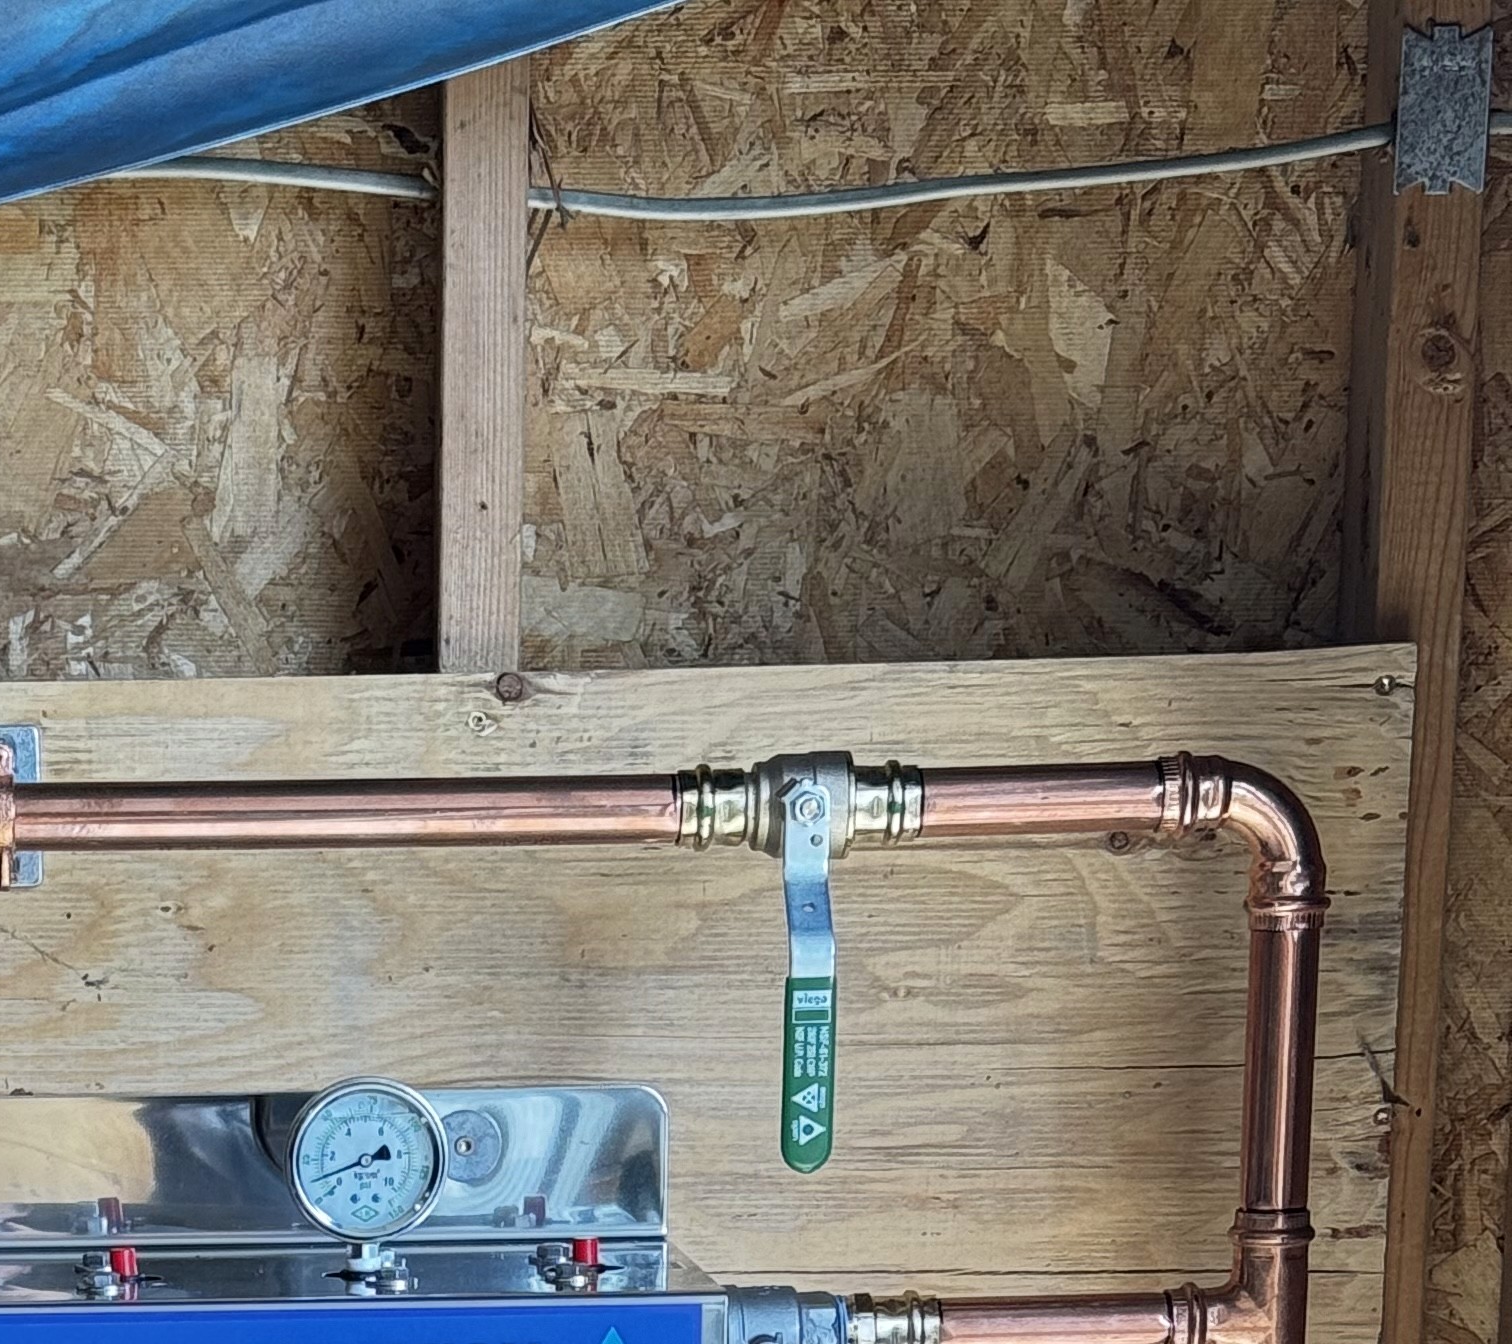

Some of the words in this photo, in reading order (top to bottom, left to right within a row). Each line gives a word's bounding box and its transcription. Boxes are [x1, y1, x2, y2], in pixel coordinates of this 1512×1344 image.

[797, 992, 827, 1005] viega
[345, 1128, 351, 1137] 4
[329, 1151, 335, 1161] 2
[336, 1177, 342, 1186] 0
[384, 1177, 394, 1186] 10
